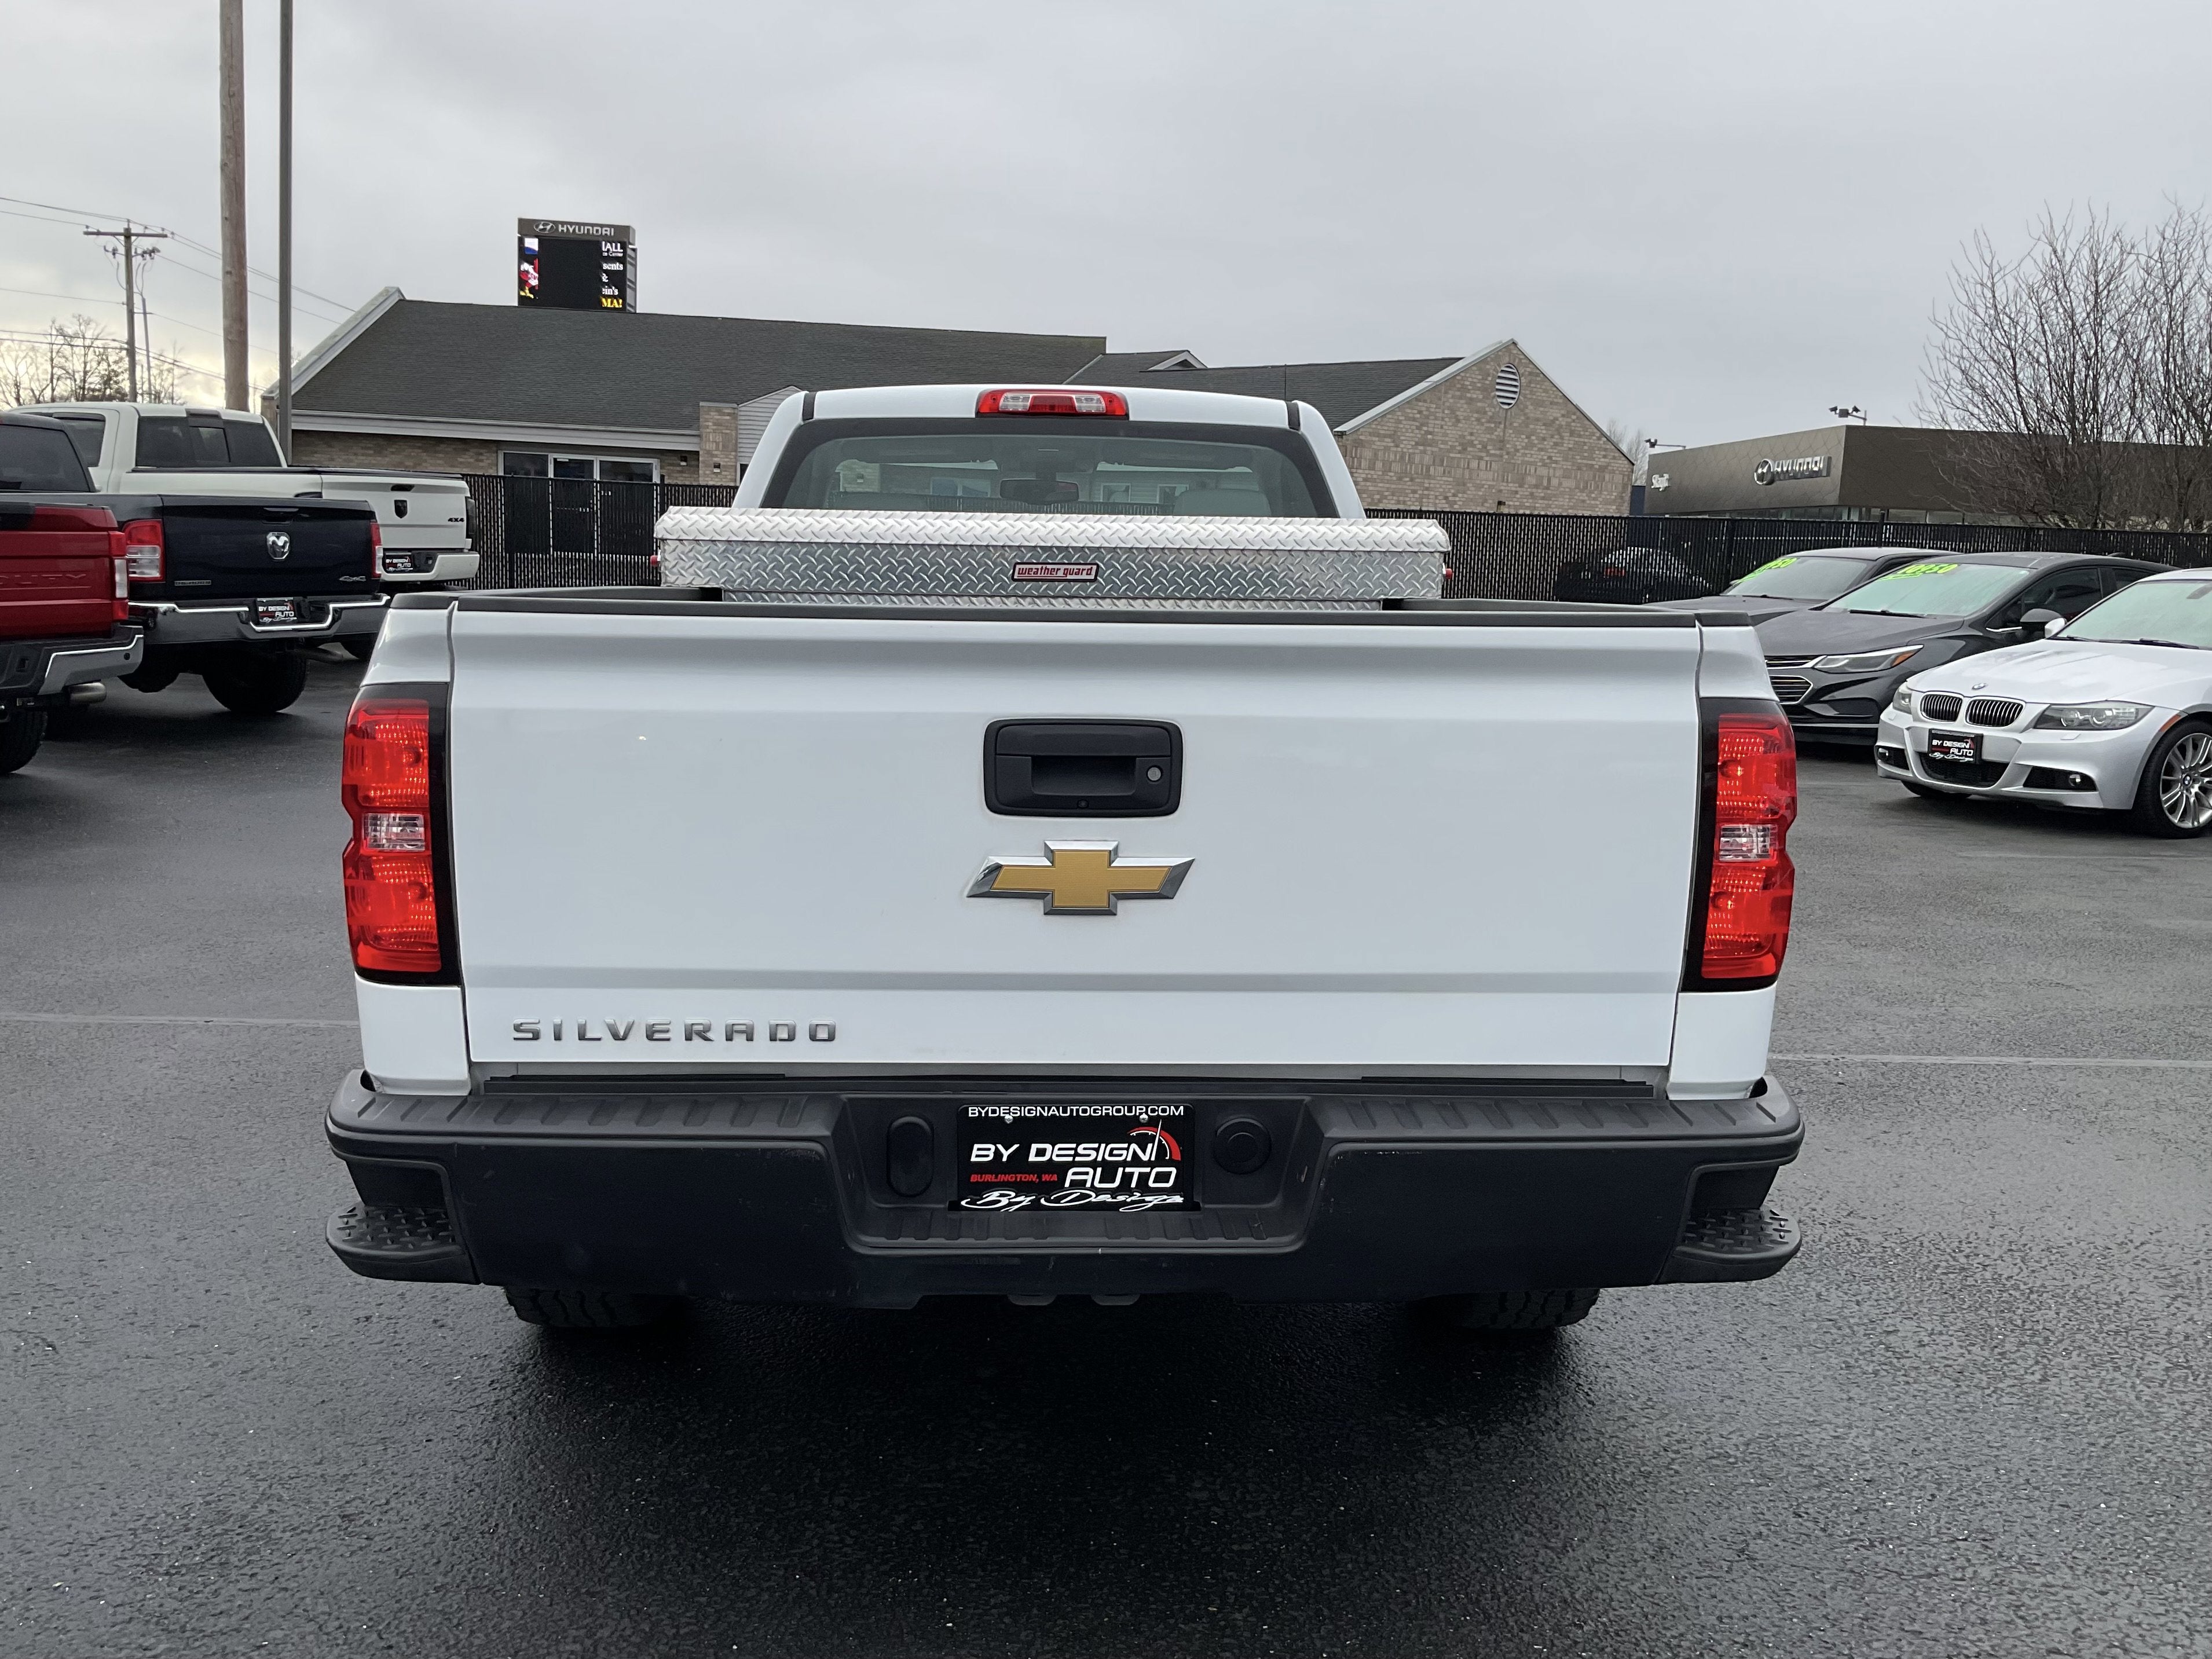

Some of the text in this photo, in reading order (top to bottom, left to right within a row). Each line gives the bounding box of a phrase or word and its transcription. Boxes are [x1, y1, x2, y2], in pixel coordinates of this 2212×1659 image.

[558, 224, 614, 236] HYUNDAI
[1017, 566, 1093, 578] weather guard
[1950, 748, 1973, 756] AUTO
[513, 1019, 836, 1041] SILVERADO
[971, 1143, 1156, 1162] BY DESIGN
[971, 1174, 1039, 1182] BURLINGTON,
[1064, 1167, 1177, 1188] AUTO
[961, 1191, 1037, 1212] By
